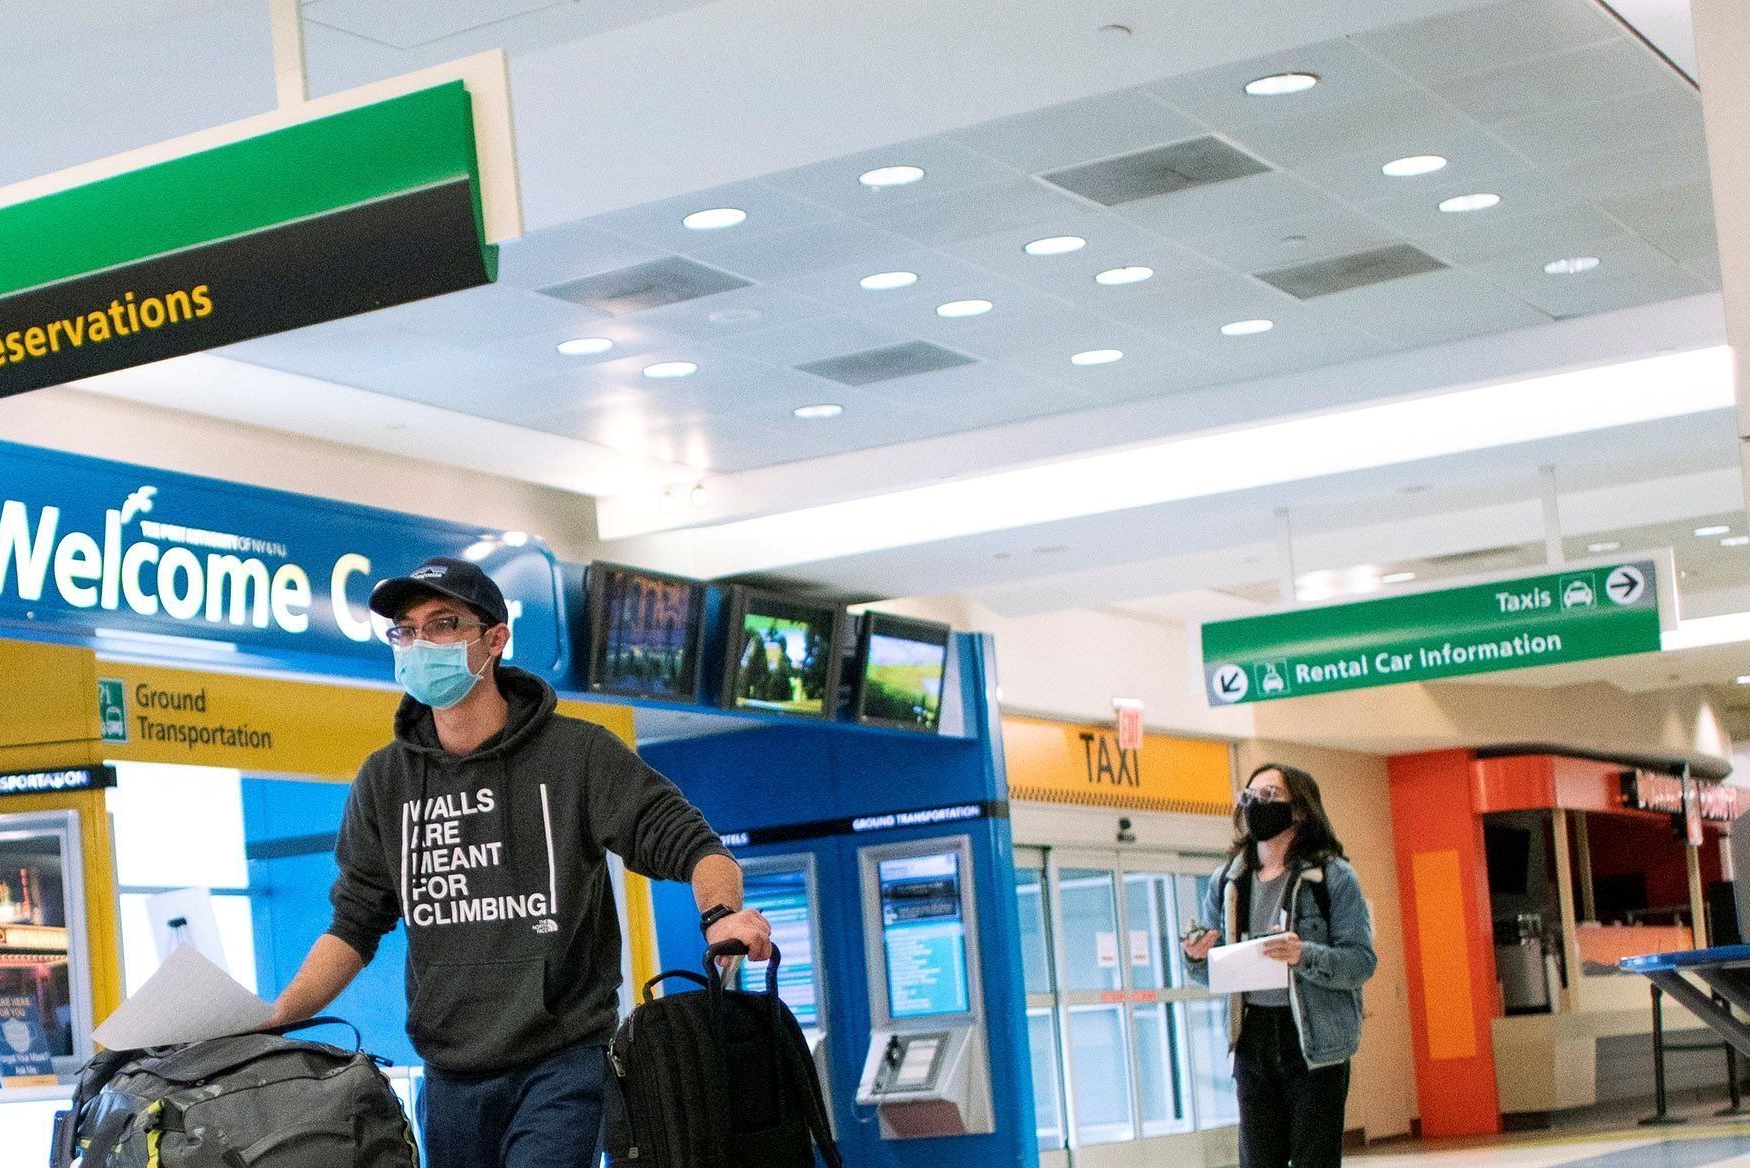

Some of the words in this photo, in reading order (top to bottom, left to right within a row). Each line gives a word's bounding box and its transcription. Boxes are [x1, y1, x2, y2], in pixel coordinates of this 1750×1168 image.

[1495, 589, 1551, 613] Taxis
[1295, 654, 1368, 685] Rental
[1374, 651, 1413, 675] Car
[1419, 630, 1562, 668] Information
[135, 683, 206, 713] Ground
[137, 715, 273, 749] Transportation
[1079, 732, 1140, 787] TAXI
[410, 788, 495, 822] WALLS
[852, 814, 895, 831] GROUND
[896, 804, 981, 826] TRANSPORTATION
[411, 821, 461, 849] ARE
[719, 831, 749, 847] OTELS
[412, 842, 502, 875] MEANT
[412, 873, 469, 901] FOR
[413, 893, 547, 926] CLIMBING
